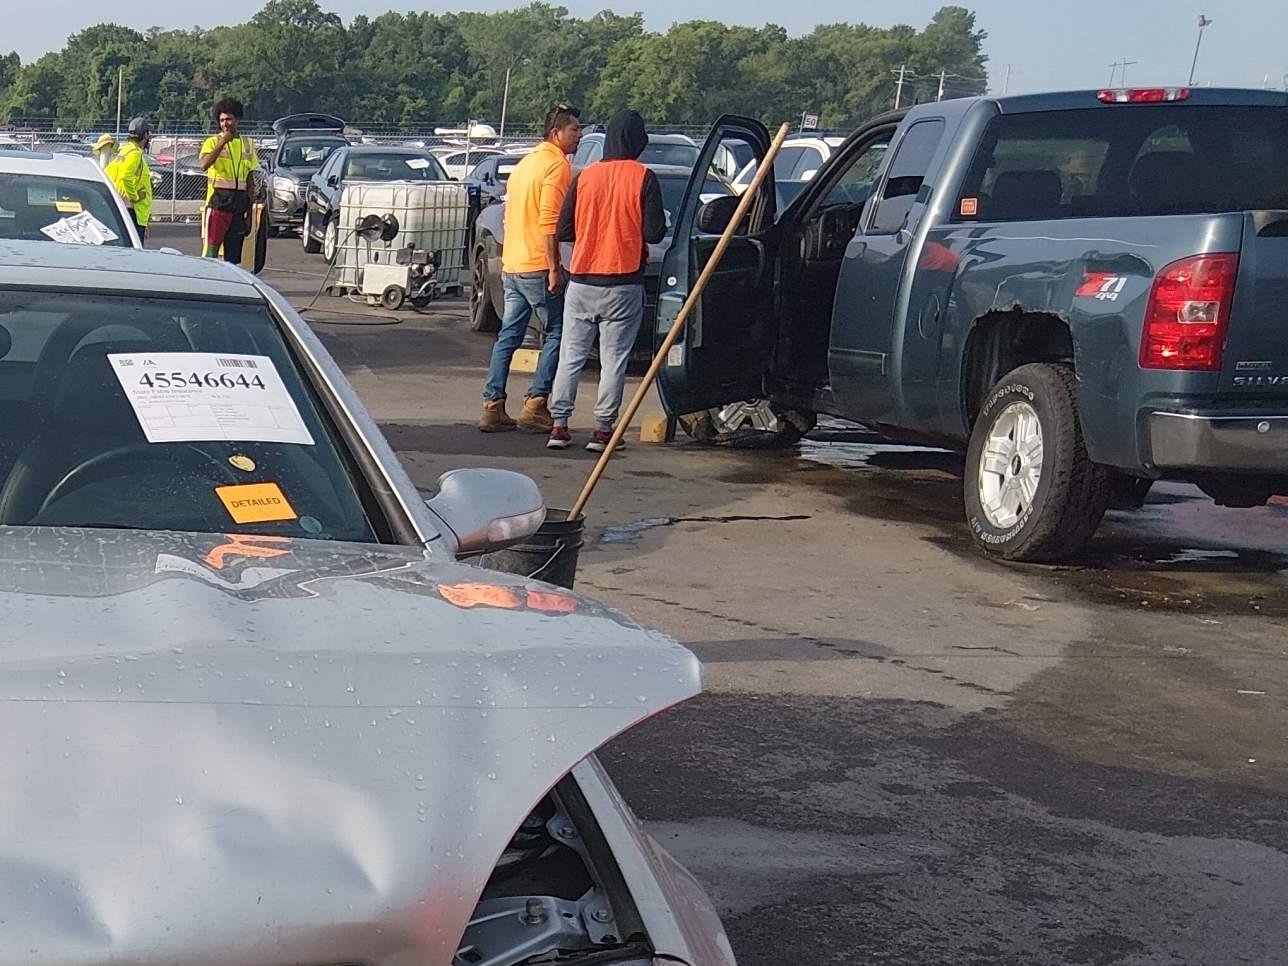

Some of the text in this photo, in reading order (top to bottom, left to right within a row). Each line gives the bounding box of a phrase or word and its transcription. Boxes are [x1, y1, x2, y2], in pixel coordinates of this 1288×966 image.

[805, 118, 816, 127] 50
[139, 372, 266, 390] 45546644
[231, 497, 281, 508] DETAILED
